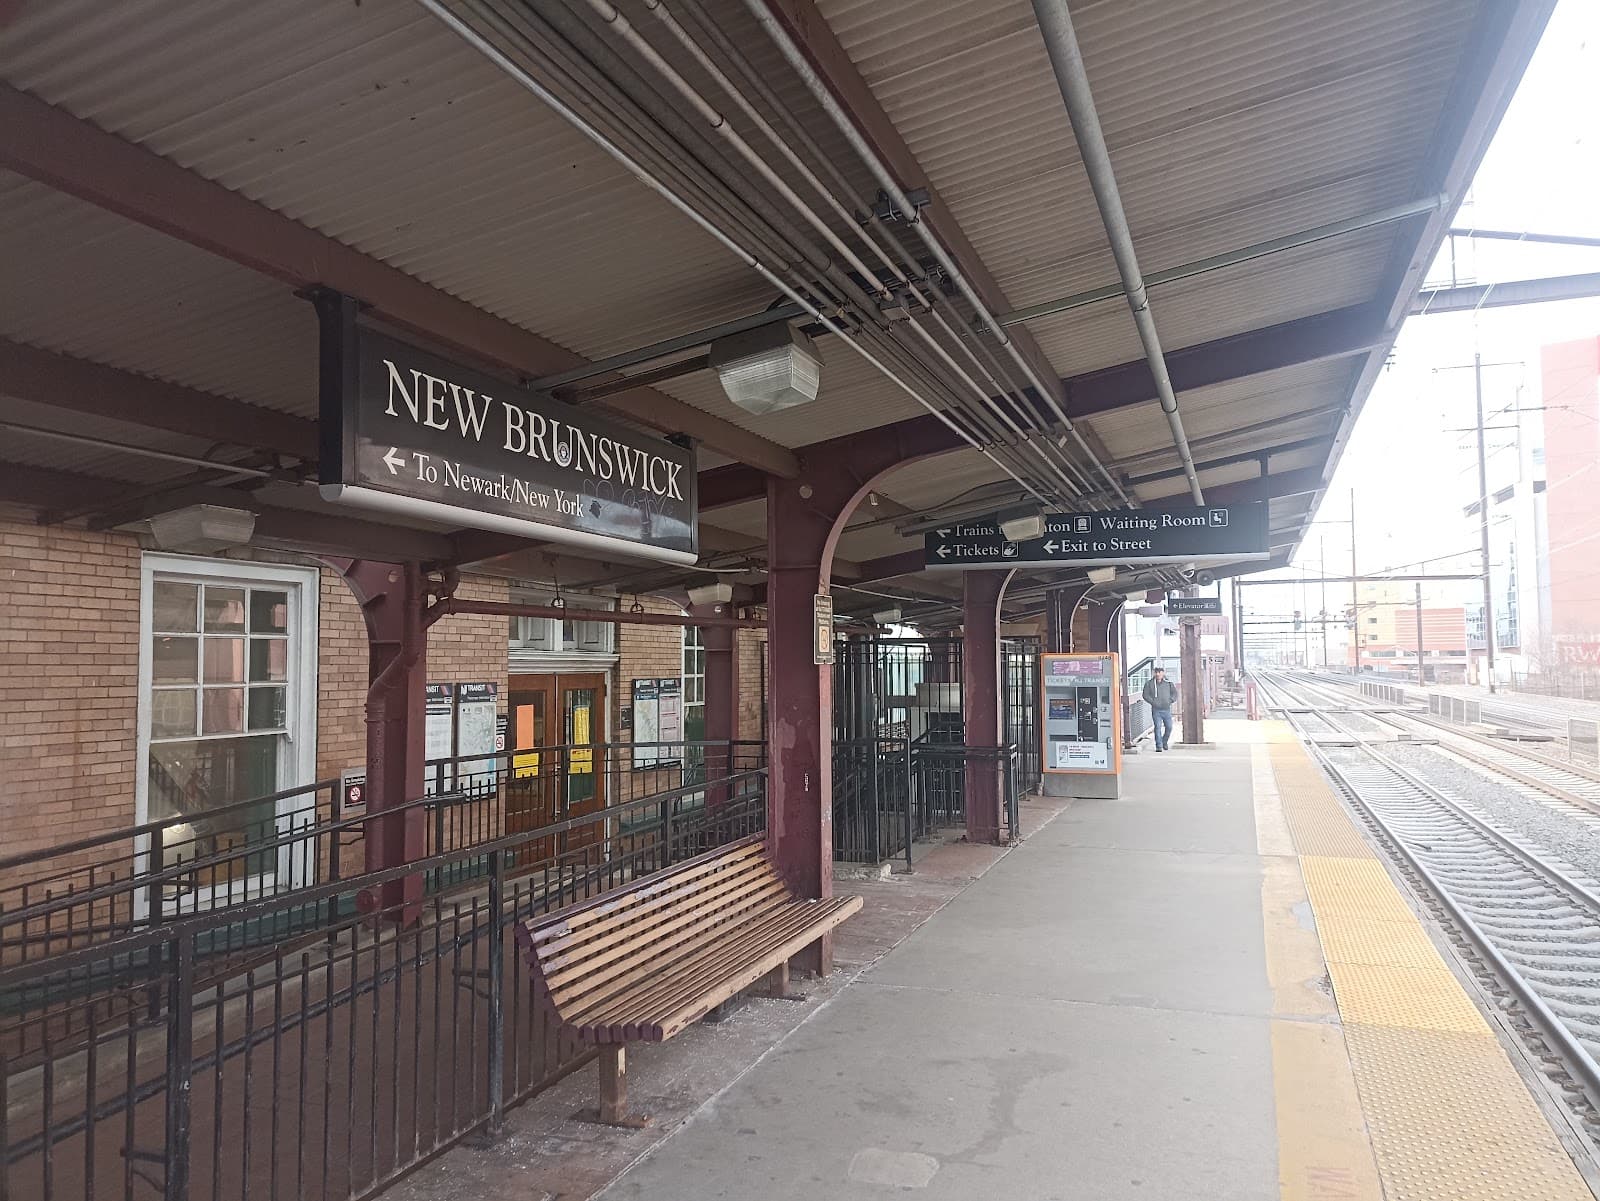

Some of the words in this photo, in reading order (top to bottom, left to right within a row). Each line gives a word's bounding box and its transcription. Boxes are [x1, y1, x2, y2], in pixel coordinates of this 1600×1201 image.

[383, 359, 493, 443] NEW
[502, 401, 684, 501] BRUNSWICK
[412, 452, 438, 483] To
[443, 460, 550, 509] Newark/New
[554, 489, 584, 518] York
[955, 524, 994, 537] Trains
[1100, 516, 1157, 531] Waiting
[1161, 514, 1206, 527] Room
[952, 544, 1000, 557] Tickets
[1061, 539, 1089, 553] Exit
[1093, 541, 1107, 551] to
[1110, 537, 1152, 550] Street
